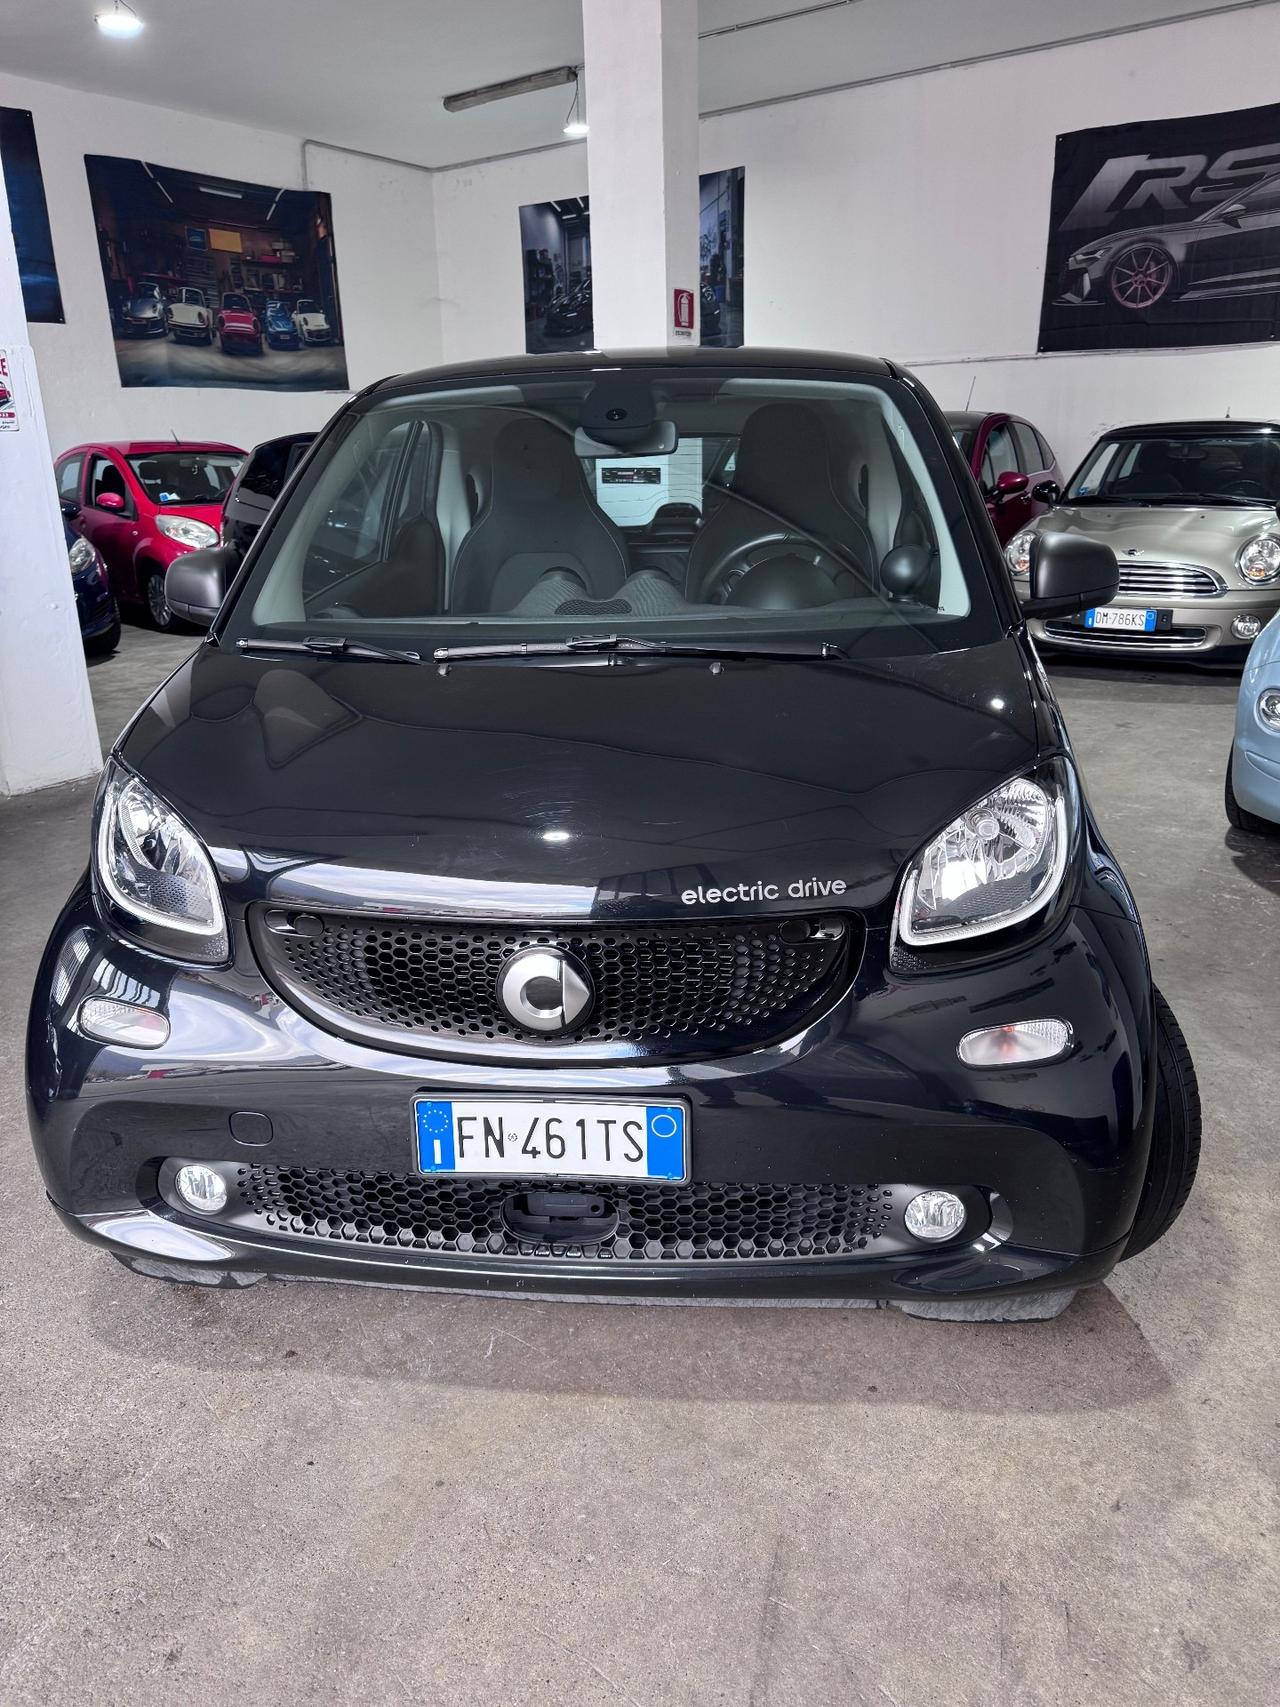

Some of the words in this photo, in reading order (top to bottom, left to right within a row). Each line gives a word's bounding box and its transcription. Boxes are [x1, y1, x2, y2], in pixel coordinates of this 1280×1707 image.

[1095, 611, 1109, 625] DM
[1111, 612, 1145, 627] 786KS
[681, 880, 779, 905] electric
[787, 877, 847, 898] drive
[456, 1116, 505, 1159] FN
[521, 1117, 644, 1163] 461TS
